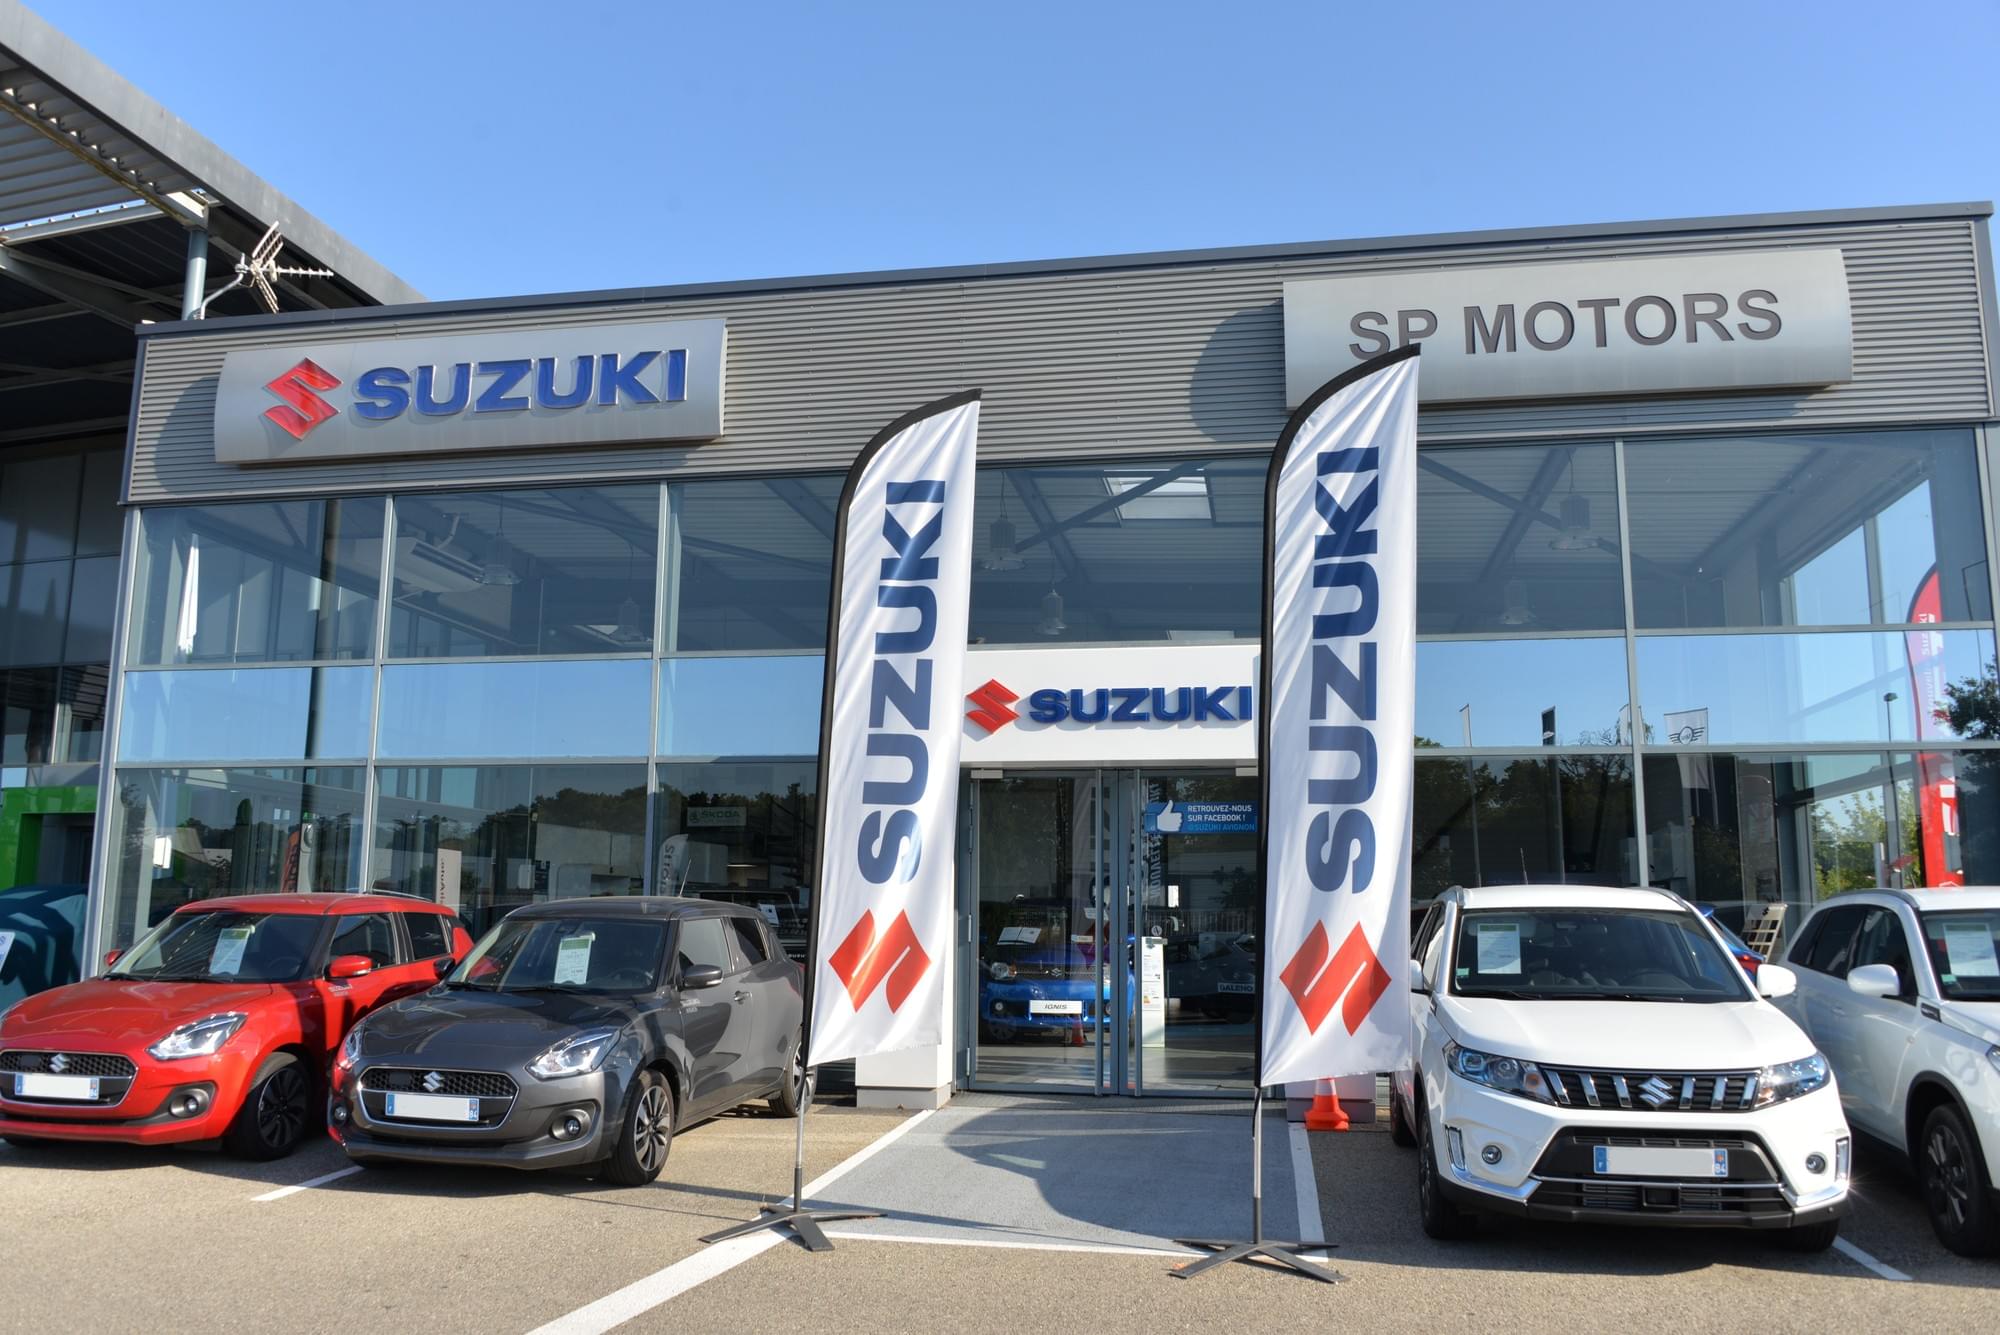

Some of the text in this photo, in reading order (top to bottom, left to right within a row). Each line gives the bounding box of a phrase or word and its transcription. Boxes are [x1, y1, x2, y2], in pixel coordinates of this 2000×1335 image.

[1348, 289, 1782, 361] SP MOTORS
[354, 349, 688, 420] SUZUKI
[857, 480, 946, 885] SUZUKI
[1029, 686, 1253, 724] SUZUKI
[1305, 446, 1380, 894] SUZUKI
[1187, 814, 1203, 822] SUR
[1204, 814, 1242, 822] FACEBOOK
[1222, 823, 1255, 831] AVIGNON
